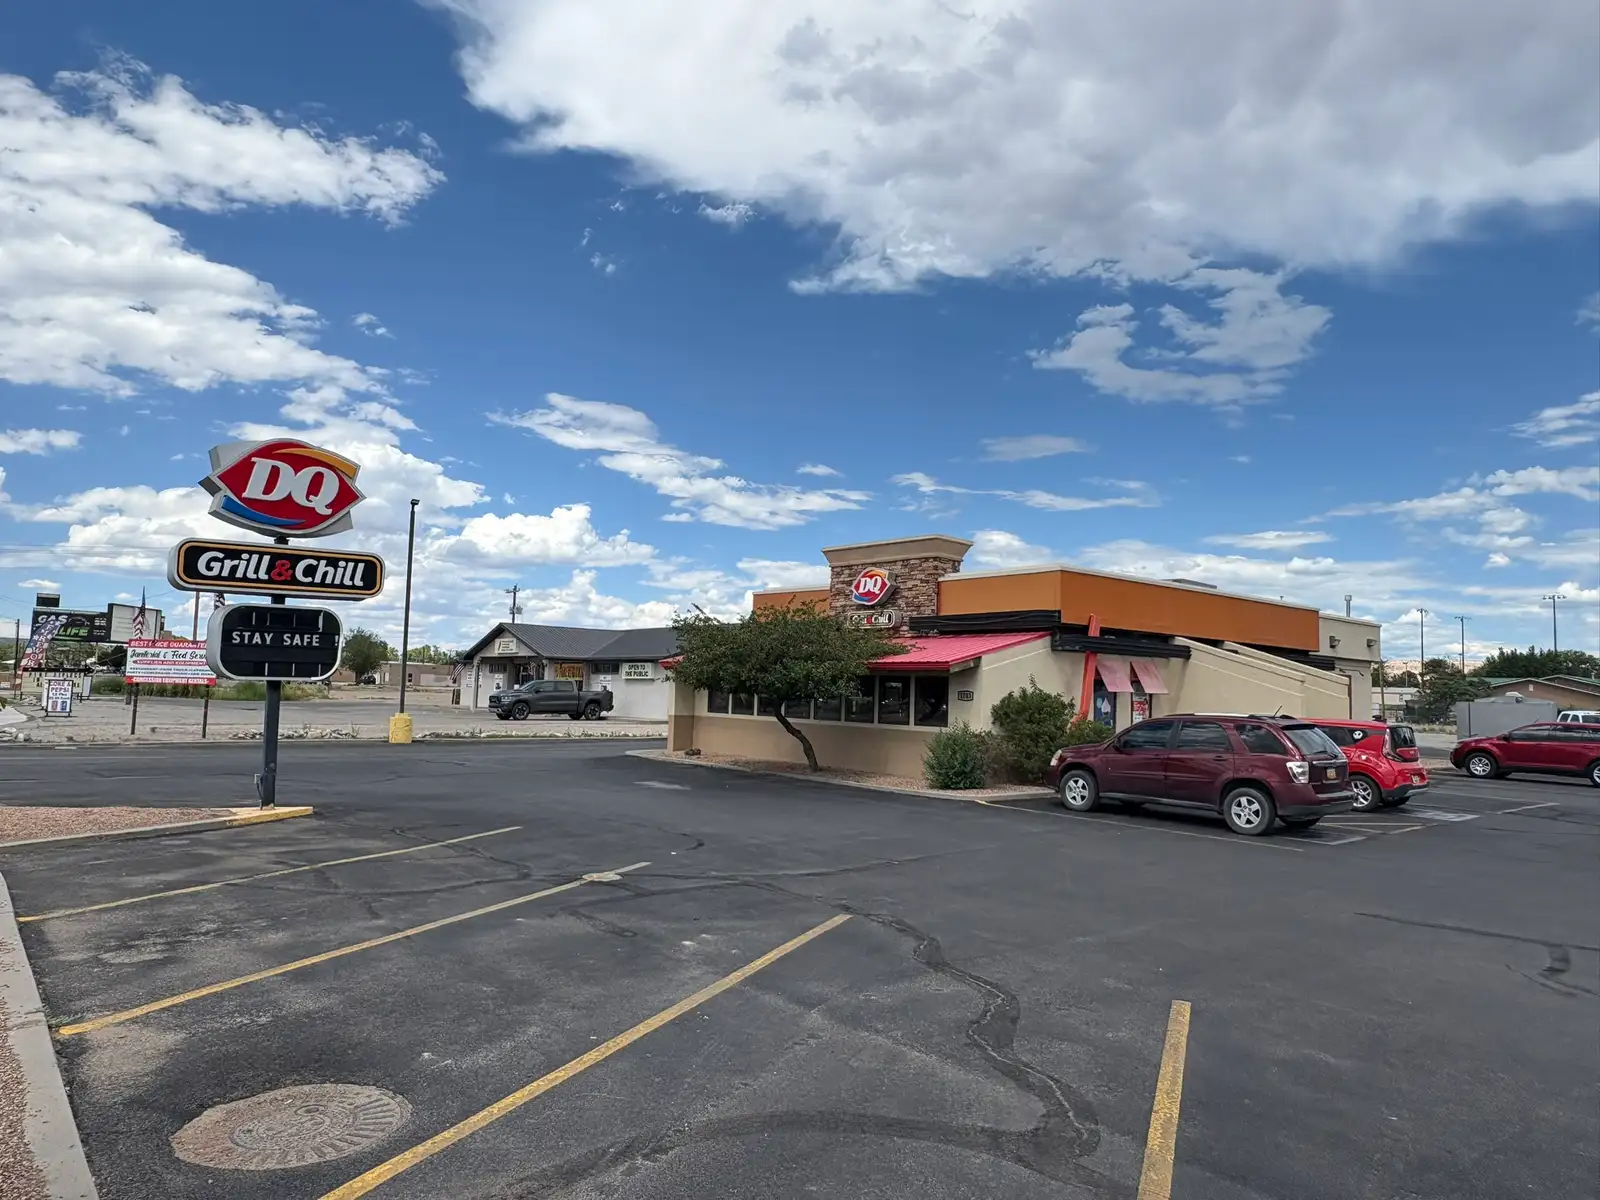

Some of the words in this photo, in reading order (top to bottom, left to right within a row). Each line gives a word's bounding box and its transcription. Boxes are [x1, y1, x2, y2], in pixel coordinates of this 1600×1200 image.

[242, 457, 340, 515] DQ
[858, 576, 881, 594] DQ
[38, 615, 68, 625] GAS
[59, 627, 90, 636] LIFE
[232, 631, 273, 645] STAY
[283, 634, 320, 646] SAFE
